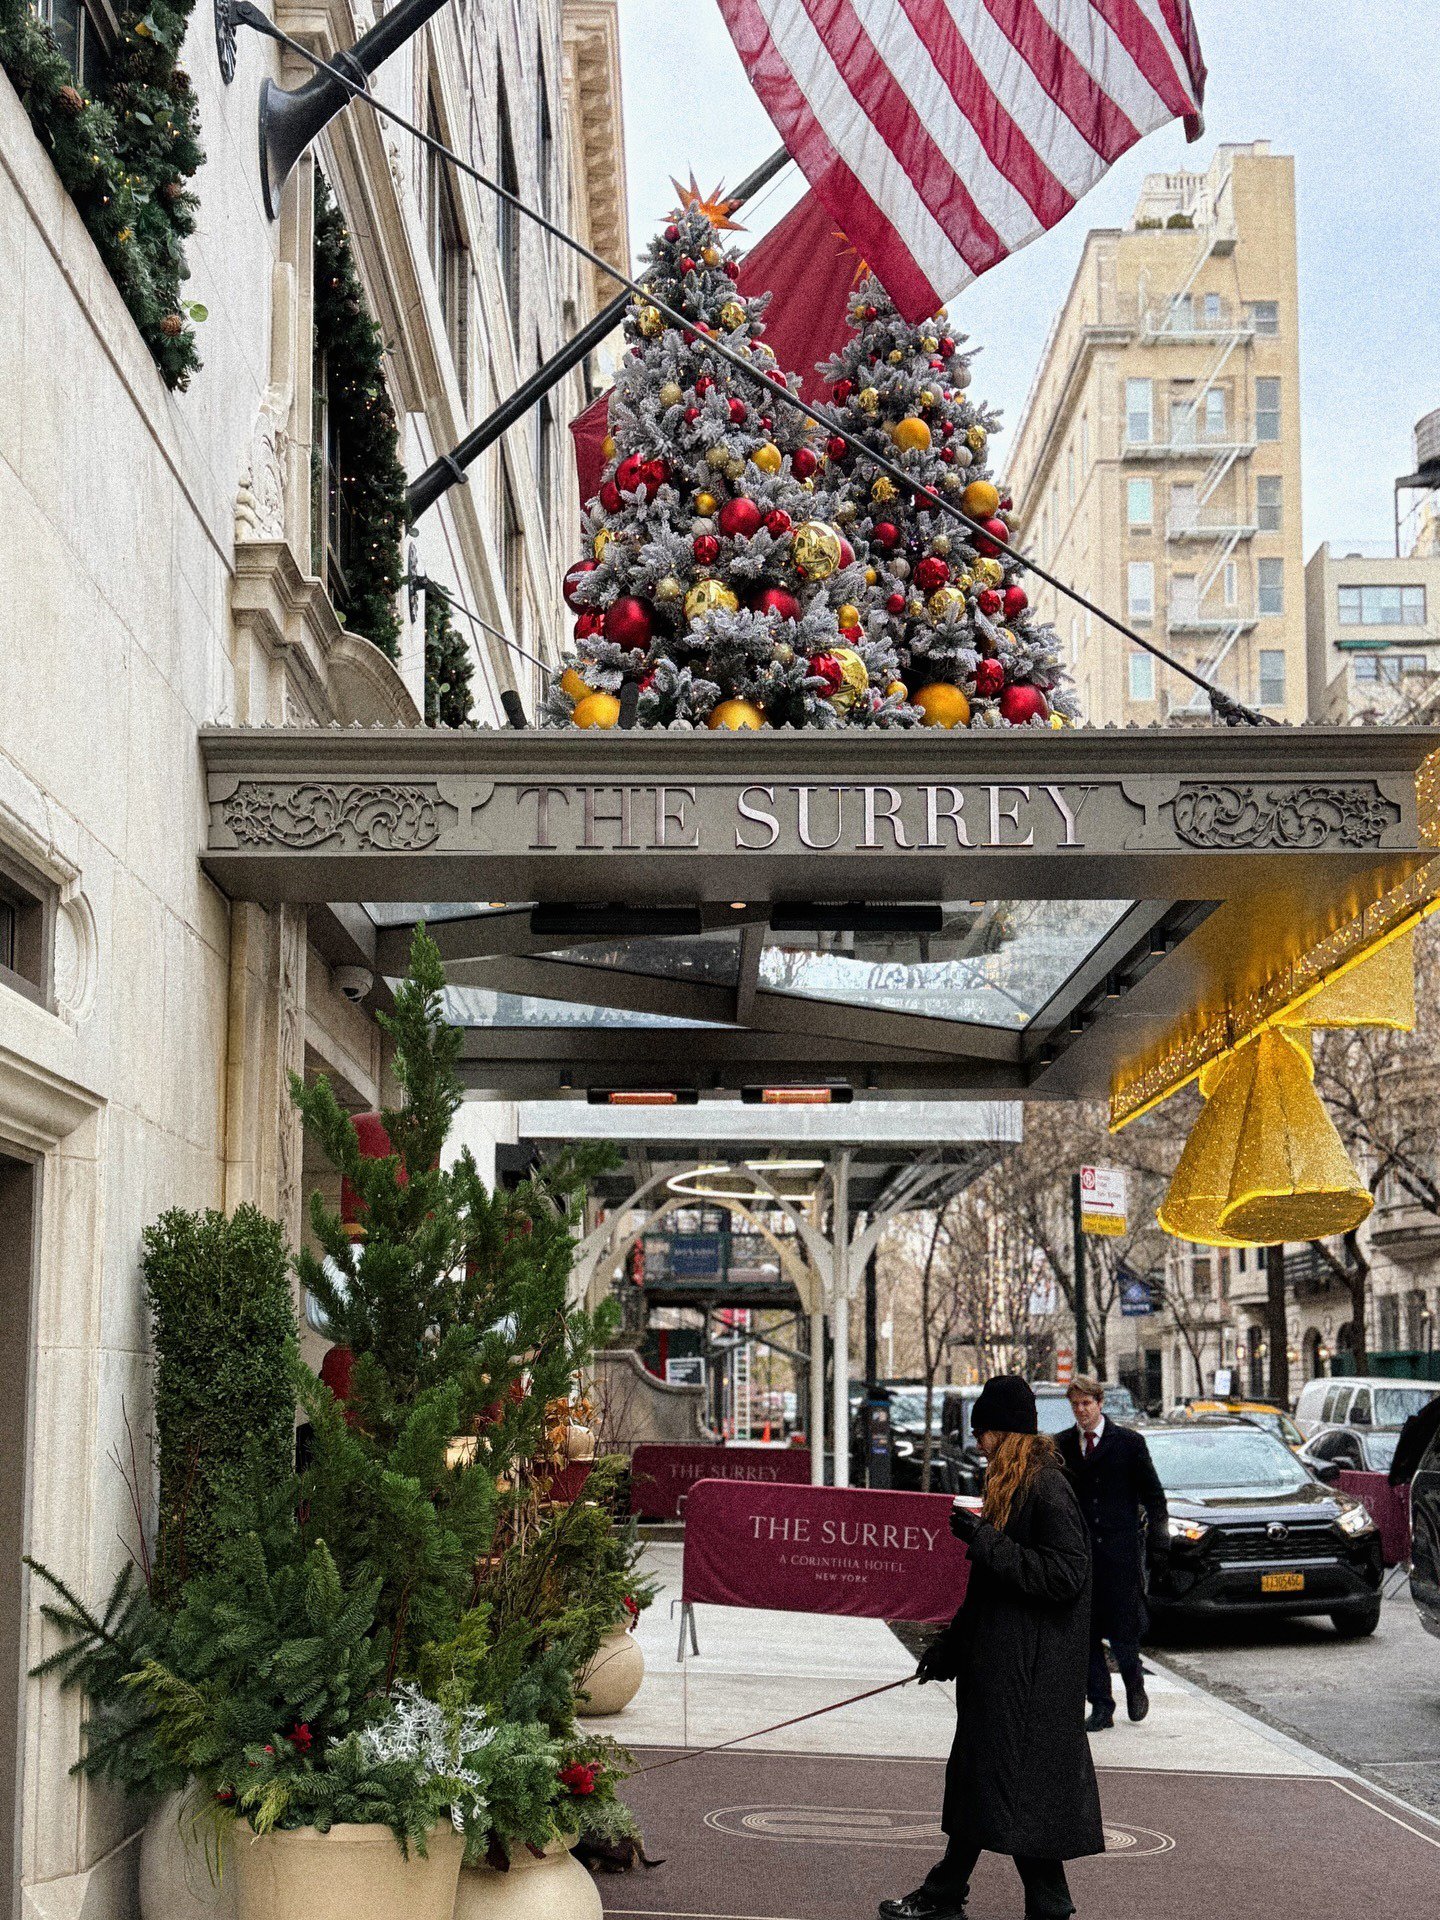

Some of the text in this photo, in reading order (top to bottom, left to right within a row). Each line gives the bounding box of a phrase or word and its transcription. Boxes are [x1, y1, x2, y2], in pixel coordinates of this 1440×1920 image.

[516, 785, 1099, 849] THE SURREY
[670, 1464, 780, 1481] THE SURREY
[749, 1515, 941, 1551] THE SURREY
[779, 1554, 906, 1573] A CORINTHIA HOTEL
[815, 1572, 868, 1583] NEW YORK
